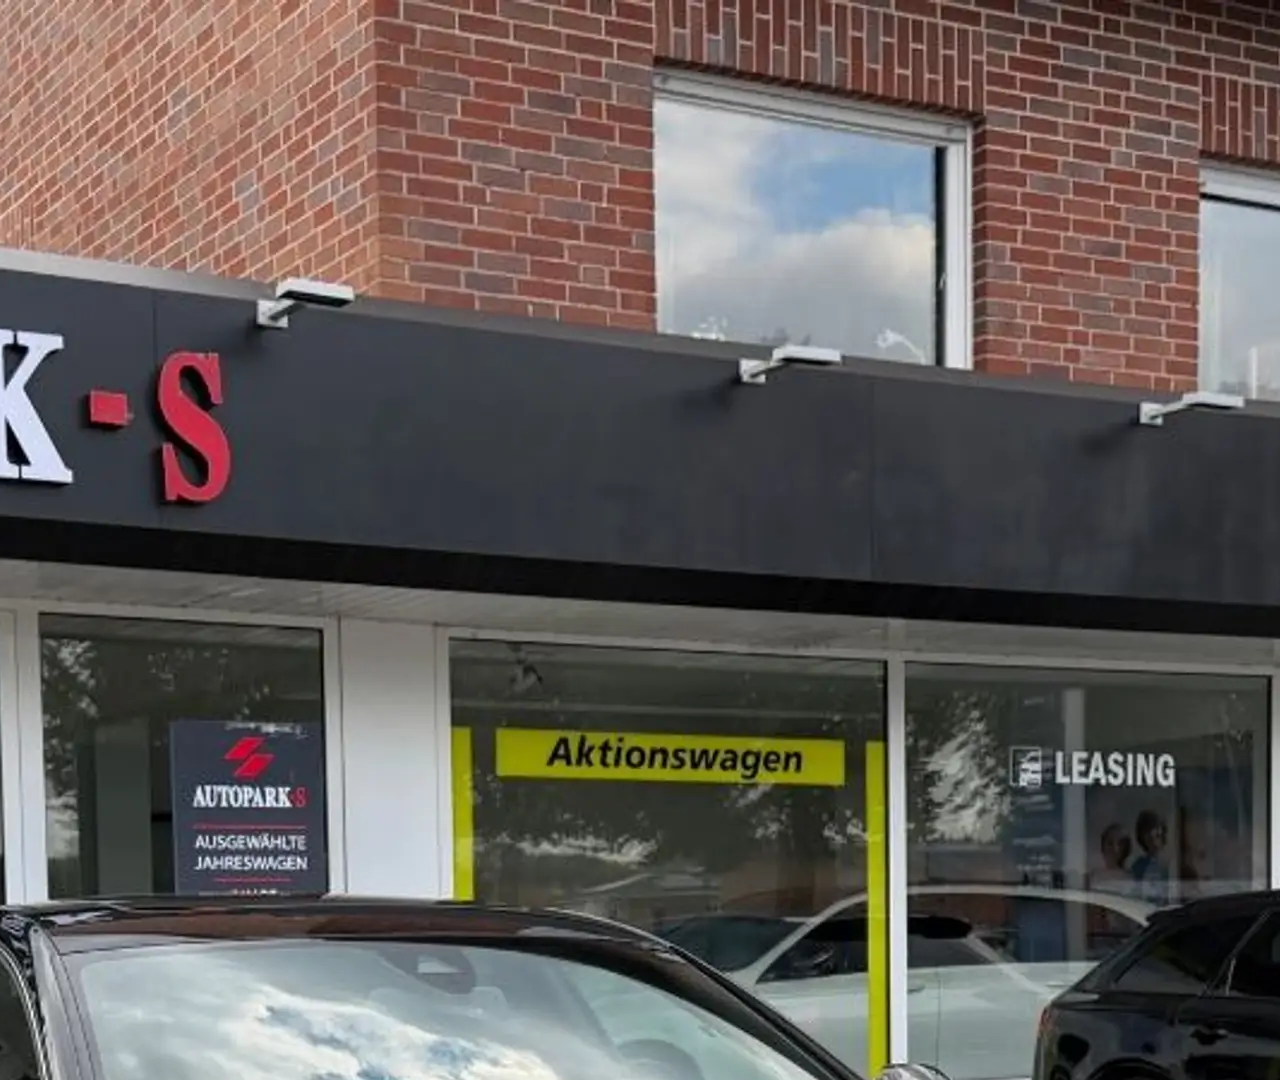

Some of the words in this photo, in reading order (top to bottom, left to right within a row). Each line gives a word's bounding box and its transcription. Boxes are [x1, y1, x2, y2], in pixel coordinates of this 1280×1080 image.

[547, 735, 803, 779] Aktionswagen
[1055, 750, 1176, 787] LEASING
[194, 832, 307, 850] AUSGEWÄHLTE
[193, 855, 308, 871] JAHRESWAGEN
